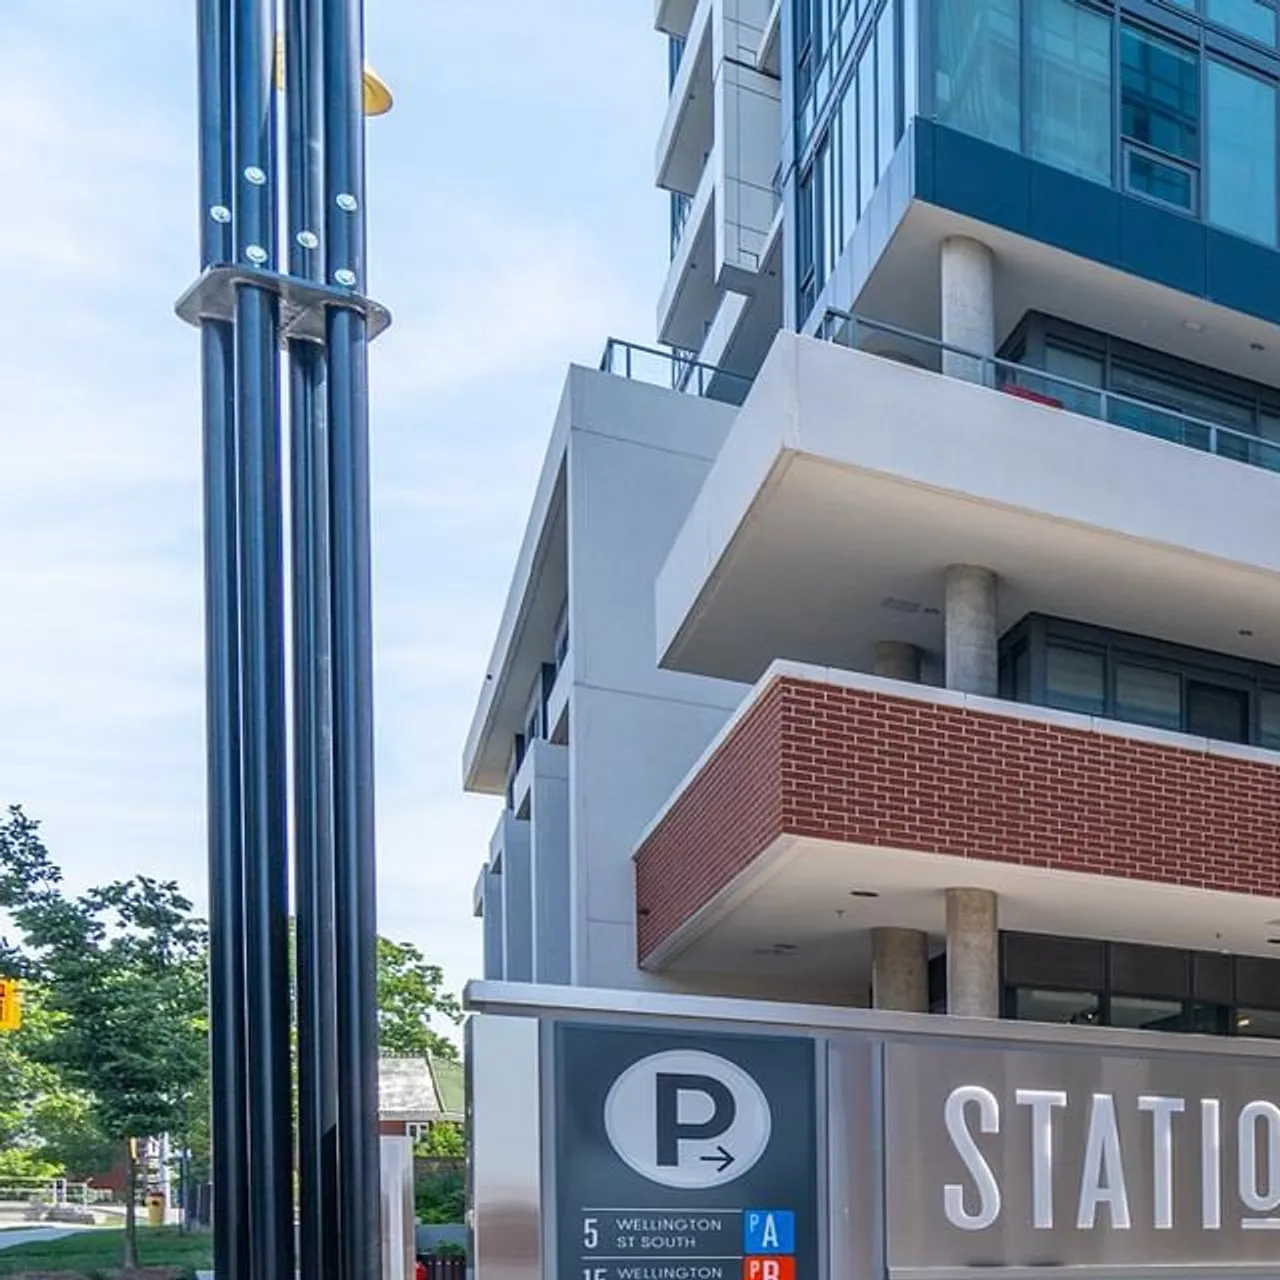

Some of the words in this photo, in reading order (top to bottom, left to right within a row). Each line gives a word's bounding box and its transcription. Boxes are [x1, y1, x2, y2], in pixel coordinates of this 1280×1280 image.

[655, 1072, 736, 1167] P
[583, 1217, 598, 1249] 5
[615, 1217, 722, 1232] WELLINGTON
[749, 1213, 760, 1234] P
[762, 1213, 780, 1249] A
[615, 1235, 635, 1249] ST
[640, 1235, 697, 1249] SOUTH
[616, 1266, 723, 1280] WELLINGTON
[749, 1260, 760, 1280] P
